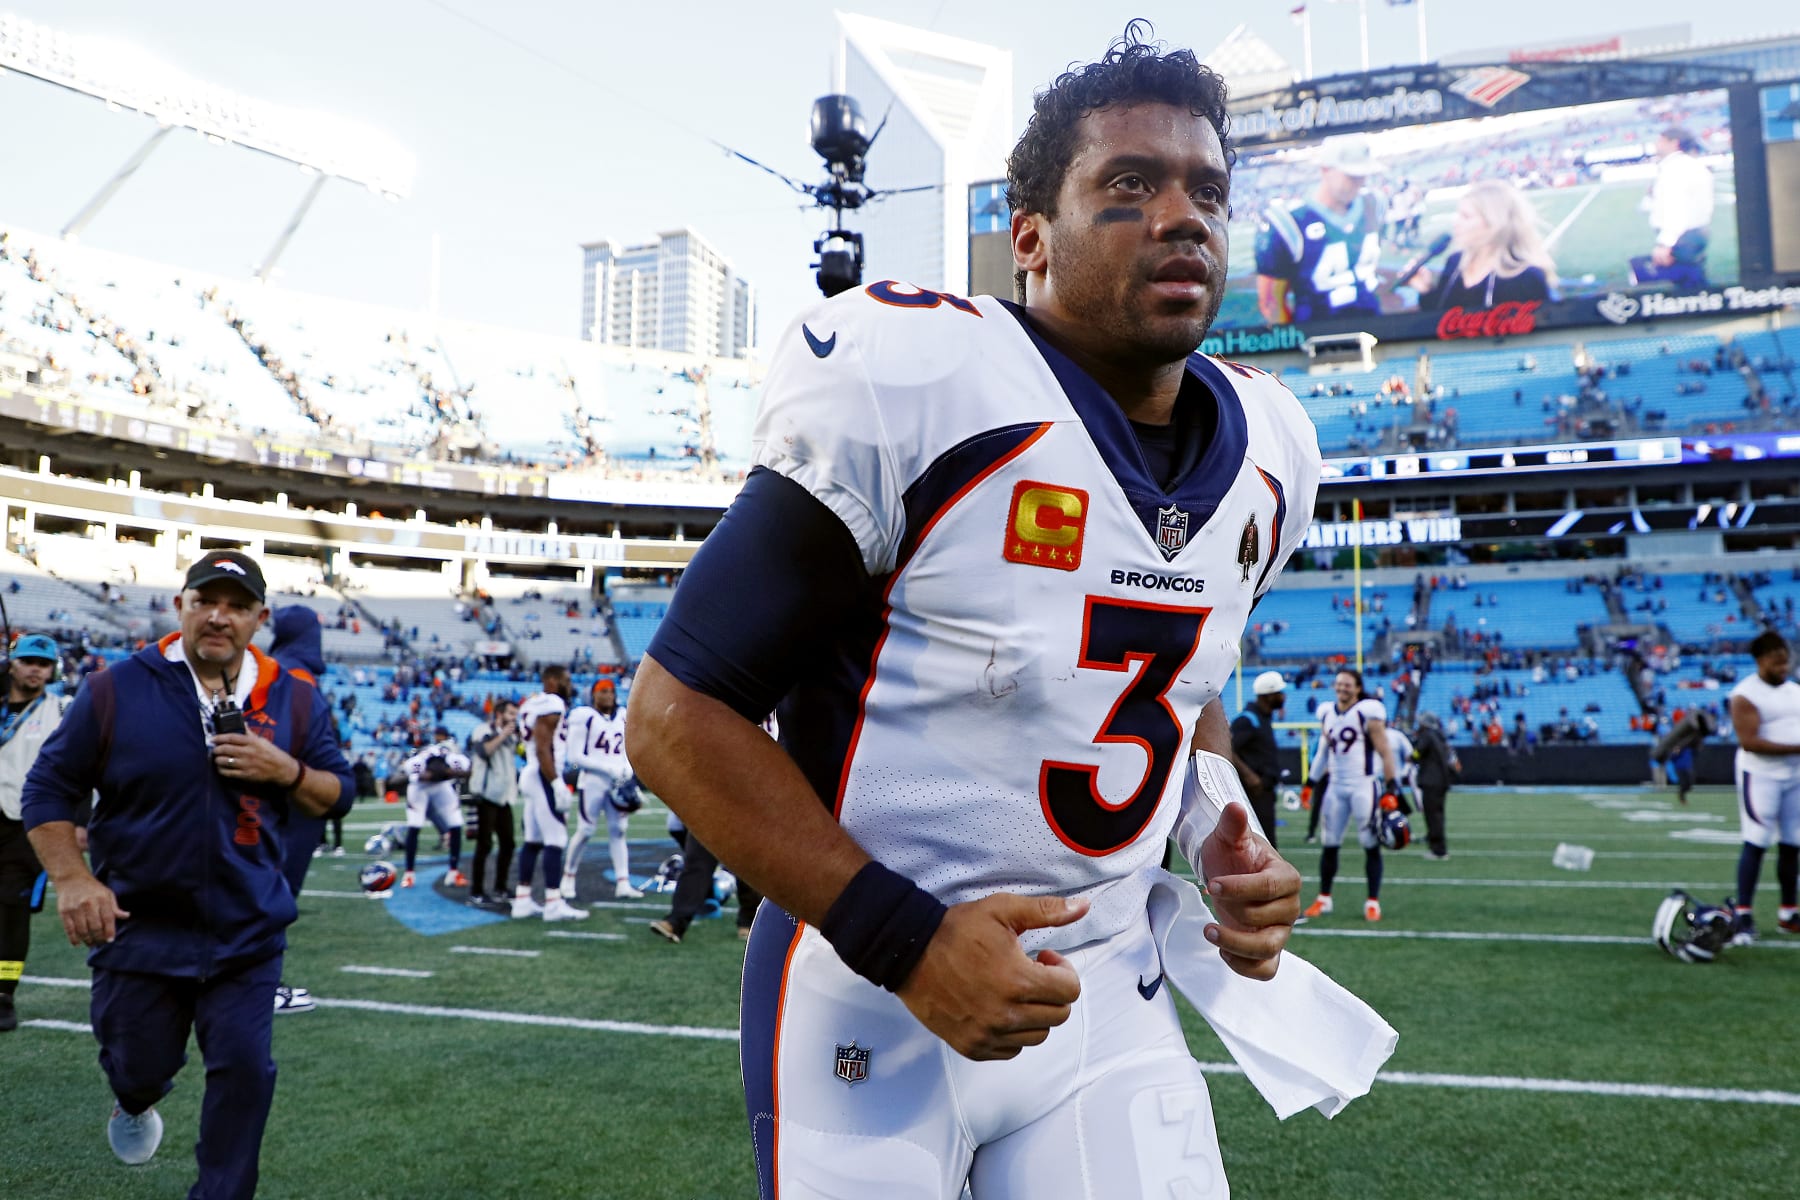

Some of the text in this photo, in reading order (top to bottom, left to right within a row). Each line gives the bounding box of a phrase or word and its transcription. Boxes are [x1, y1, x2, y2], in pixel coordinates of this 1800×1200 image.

[1230, 103, 1283, 135] ank
[1316, 87, 1443, 128] America
[1641, 290, 1723, 316] Harris
[1226, 325, 1306, 354] Health
[1014, 487, 1083, 548] C
[1161, 527, 1183, 547] NFL
[1110, 569, 1205, 593] BRONCOS
[1038, 594, 1214, 858] 3
[594, 731, 624, 755] 42
[838, 1060, 865, 1080] NFL
